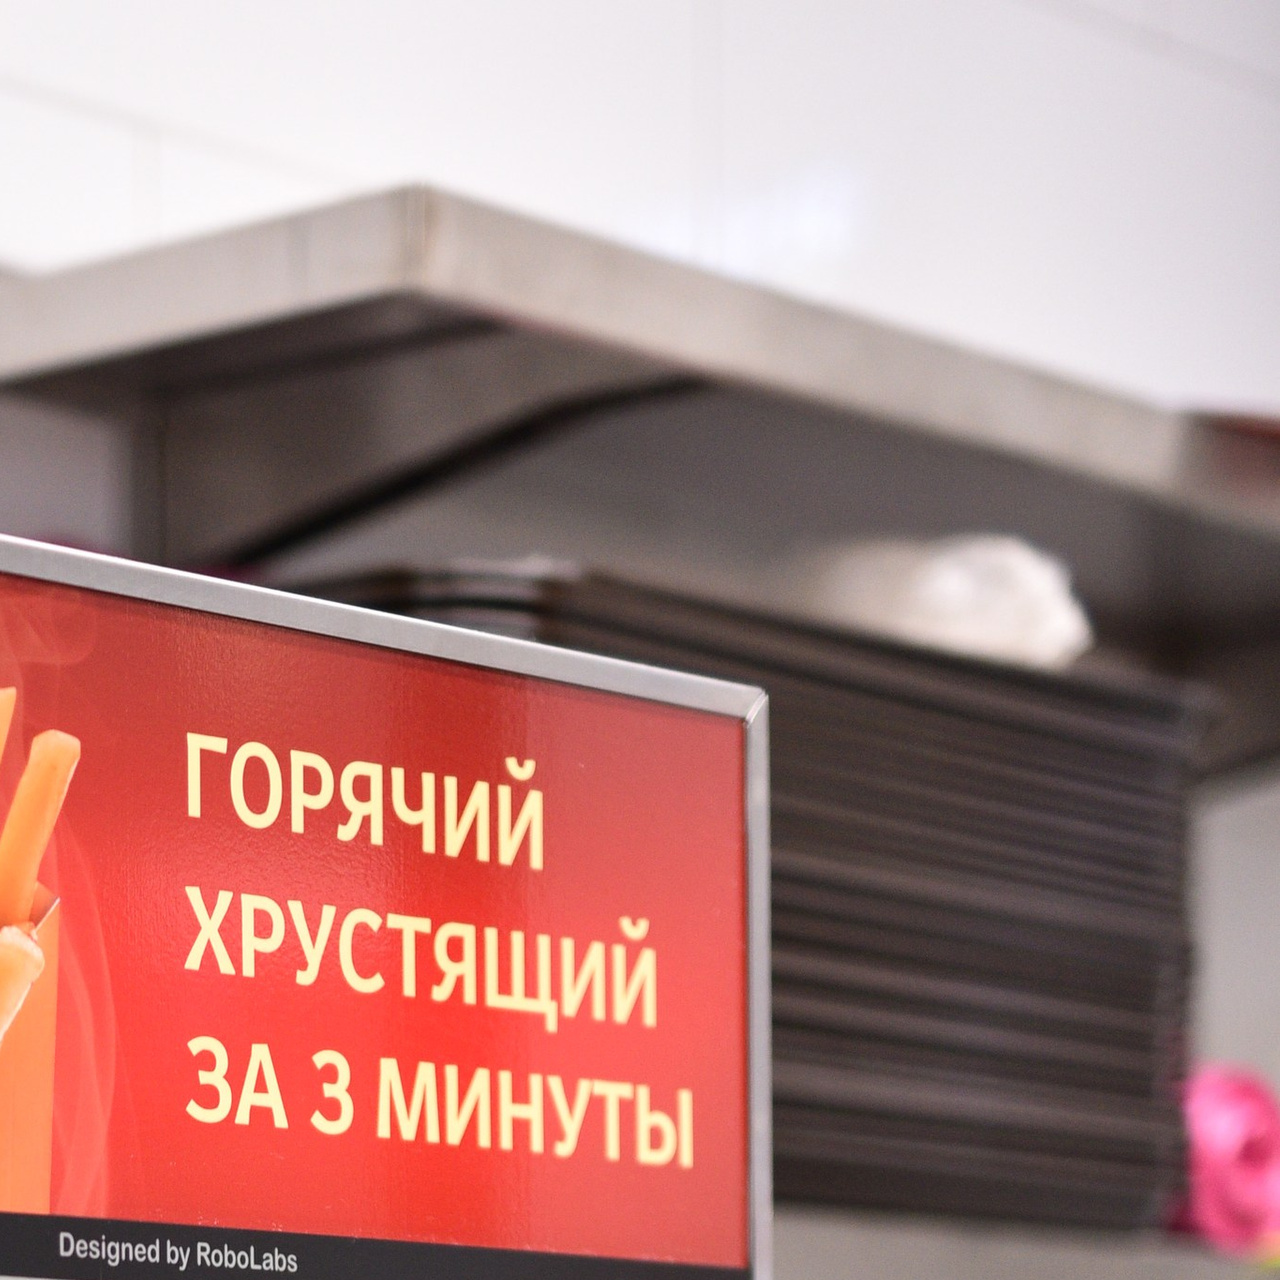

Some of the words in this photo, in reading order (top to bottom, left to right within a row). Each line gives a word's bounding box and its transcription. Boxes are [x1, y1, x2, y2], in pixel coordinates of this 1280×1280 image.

[185, 731, 544, 872] ГОРЯЧИЙ
[183, 884, 658, 1034] ХРУСТЯЩИЙ
[185, 1035, 289, 1130] ЗА
[310, 1049, 355, 1136] 3
[376, 1056, 694, 1169] МИНУТЫ
[58, 1231, 160, 1267] Designed
[166, 1238, 191, 1272] by
[196, 1241, 298, 1273] RoboLabs
